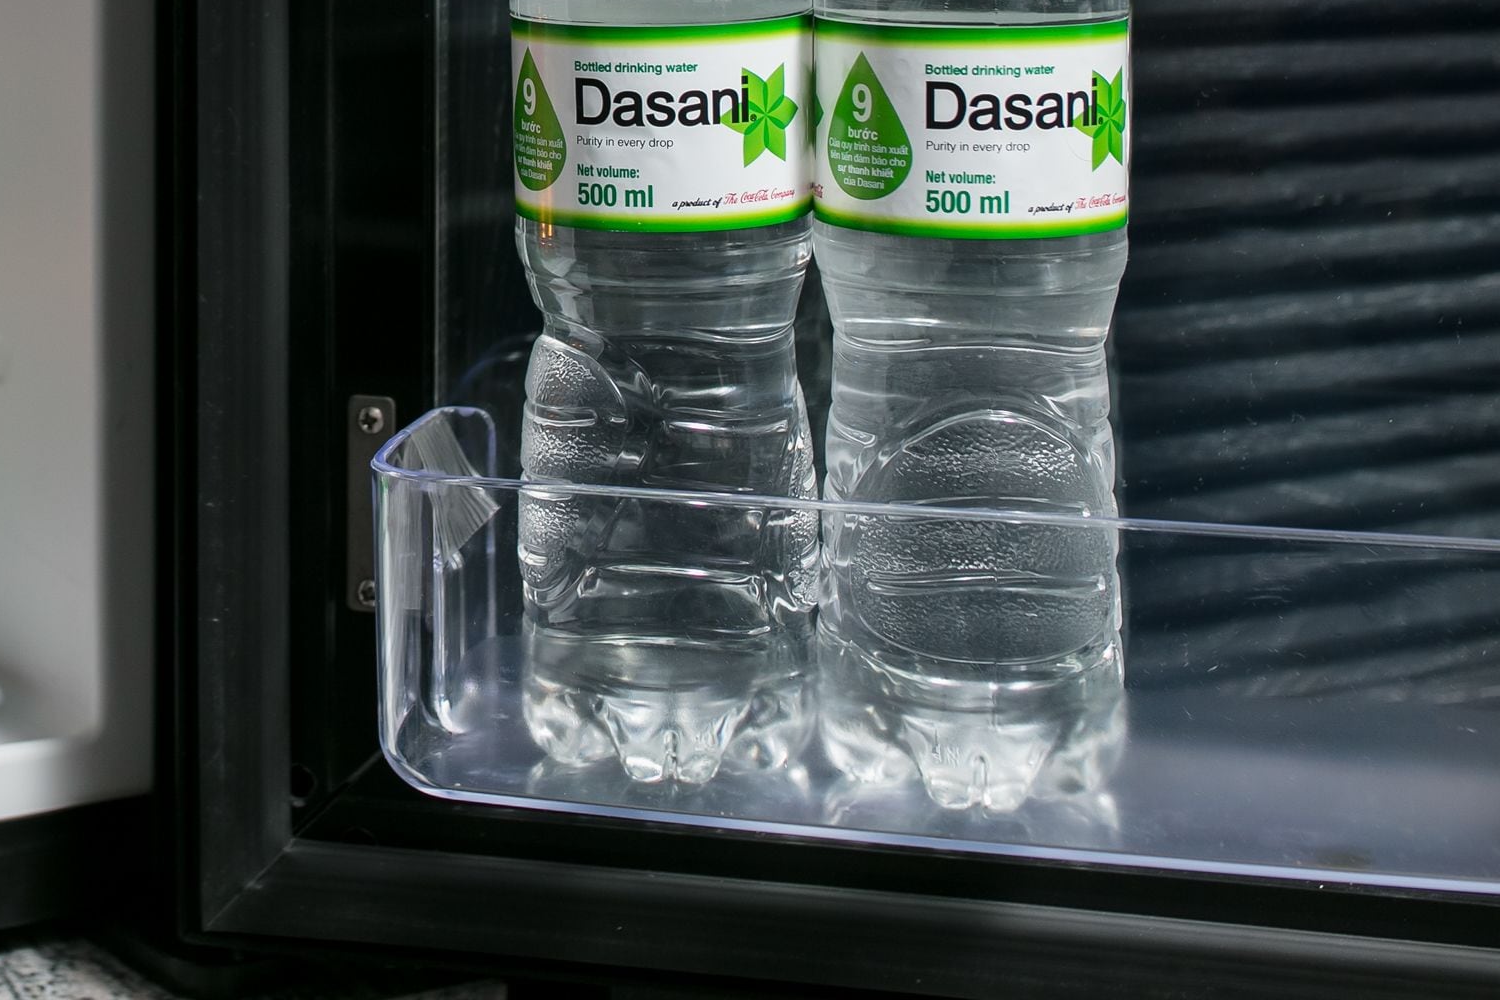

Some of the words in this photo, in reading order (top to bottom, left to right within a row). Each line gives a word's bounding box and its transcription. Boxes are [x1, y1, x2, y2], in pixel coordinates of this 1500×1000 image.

[574, 61, 612, 73] Bottled
[614, 62, 663, 76] drinking
[666, 63, 699, 73] water
[925, 64, 968, 76] Bottled
[972, 65, 1021, 79] drinking
[1025, 65, 1056, 75] water
[523, 78, 536, 116] 9
[575, 76, 749, 128] Dasani
[852, 83, 873, 123] 9
[925, 78, 1098, 131] Dasani
[847, 125, 878, 140] bước
[577, 136, 604, 149] Purity
[606, 137, 615, 147] in
[618, 139, 646, 150] every
[649, 138, 674, 150] drop
[926, 141, 956, 154] Purity
[960, 141, 969, 151] in
[973, 144, 1002, 154] every
[1006, 142, 1031, 154] drop
[848, 164, 870, 175] thanh
[889, 158, 906, 167] cho
[577, 164, 594, 177] Net
[597, 166, 640, 178] volume:
[926, 171, 945, 183] Net
[949, 171, 996, 184] volume:
[857, 178, 885, 189] Dasani
[578, 183, 617, 207] 500
[625, 185, 653, 207] ml
[678, 198, 711, 210] product
[712, 197, 722, 208] of
[724, 193, 738, 205] The
[926, 190, 970, 214] 500
[980, 191, 1009, 214] ml
[1033, 202, 1064, 216] product
[1065, 201, 1075, 213] of
